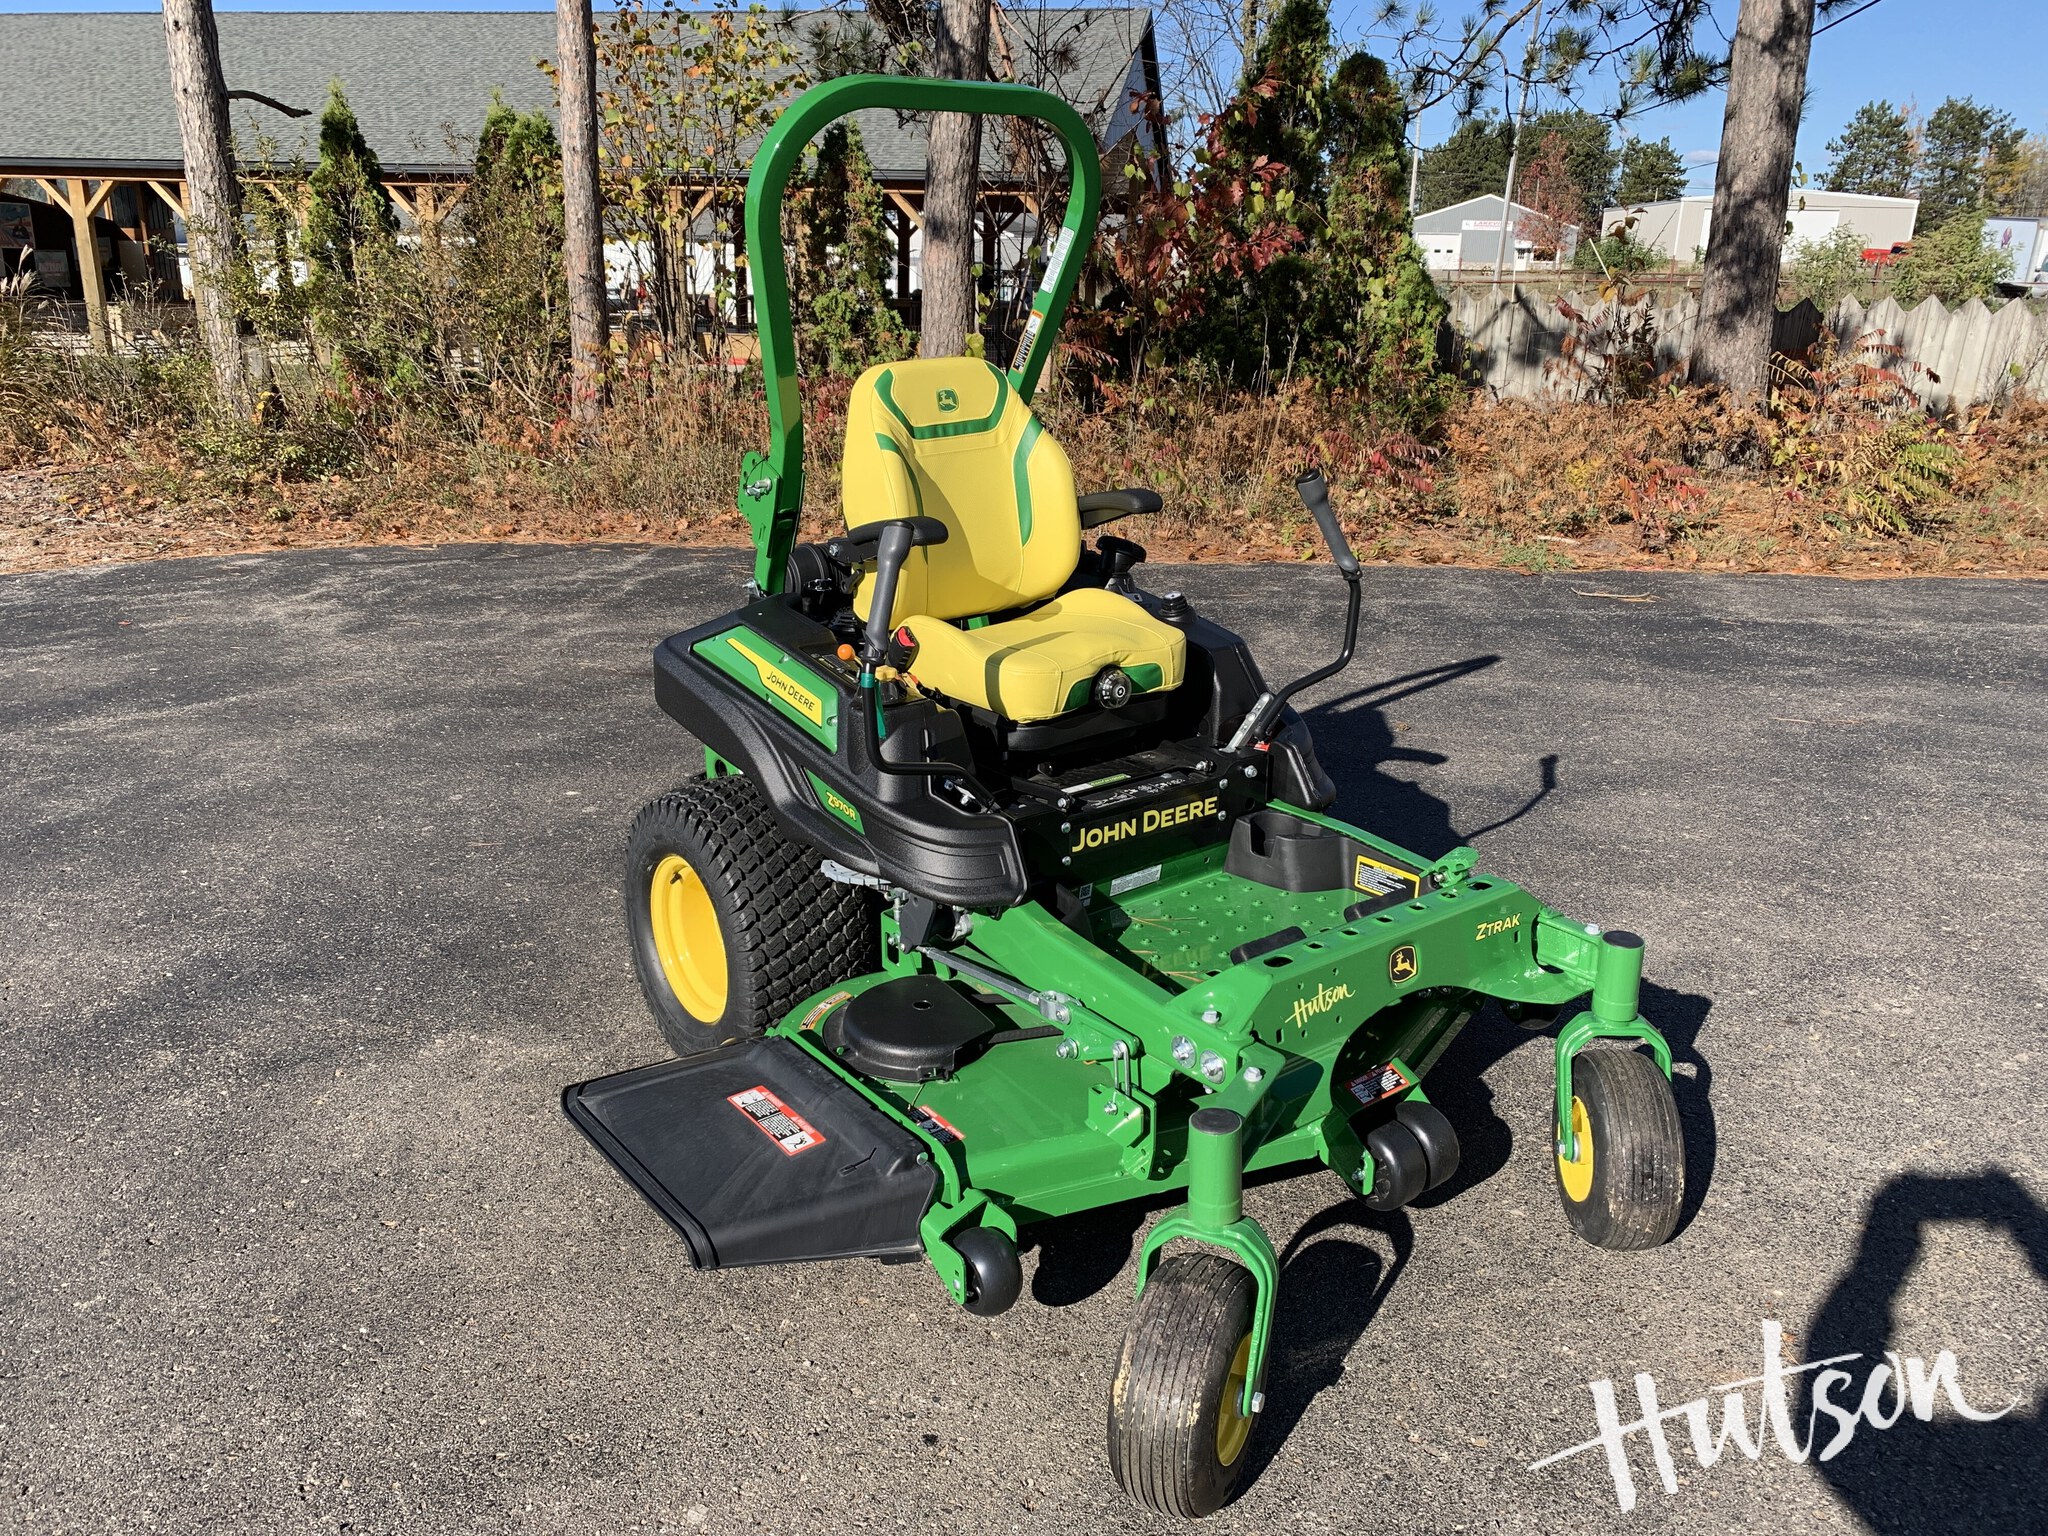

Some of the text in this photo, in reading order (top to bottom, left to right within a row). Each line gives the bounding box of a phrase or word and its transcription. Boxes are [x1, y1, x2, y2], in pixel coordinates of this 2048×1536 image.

[767, 671, 815, 711] JOHN DEERE
[826, 791, 857, 821] Z970R
[1072, 818, 1137, 853] JOHN
[1143, 796, 1218, 833] DEERE
[1475, 912, 1521, 941] ZTRAK
[1284, 983, 1356, 1029] Hutson
